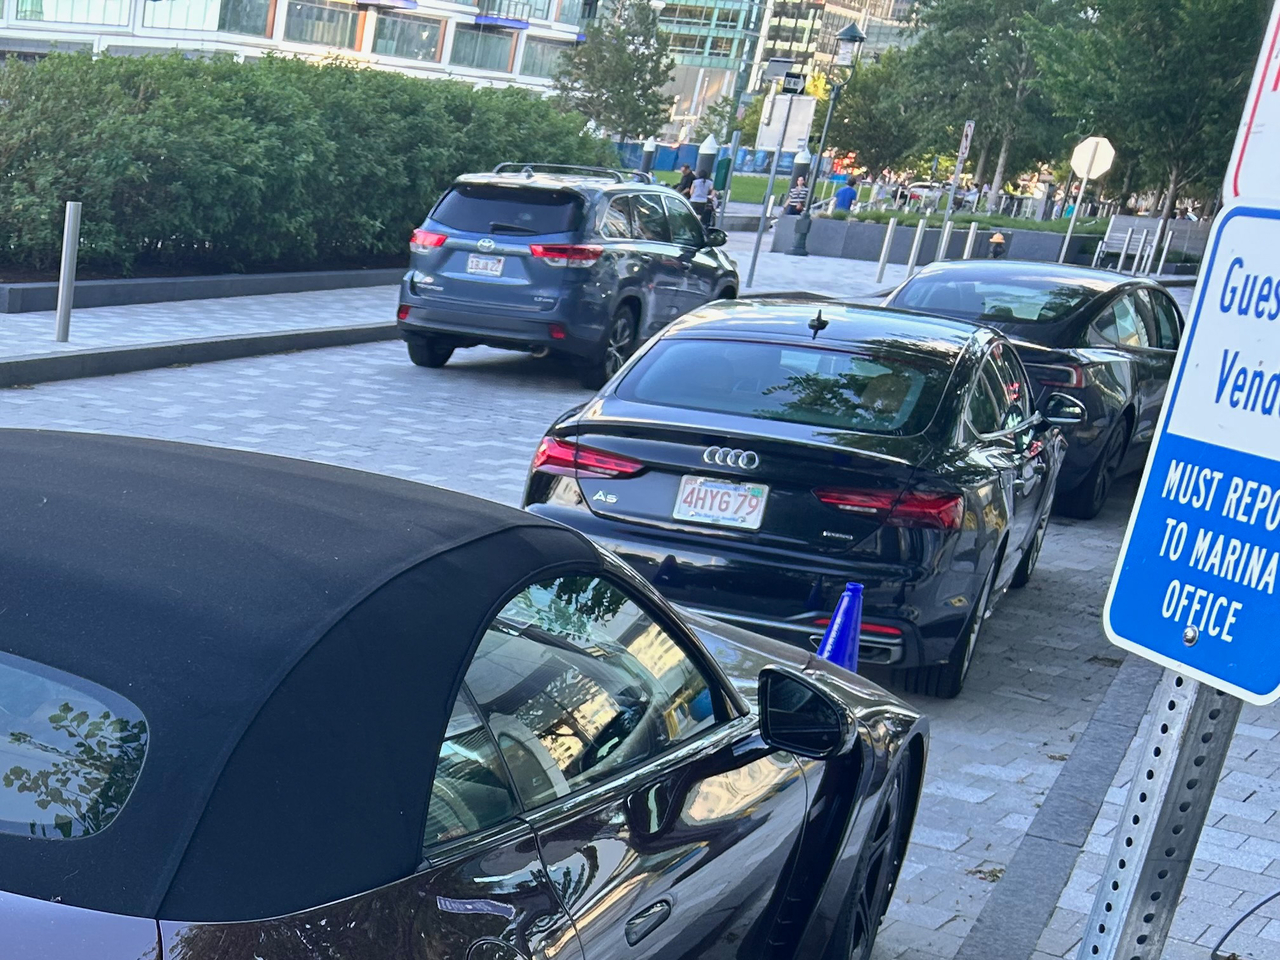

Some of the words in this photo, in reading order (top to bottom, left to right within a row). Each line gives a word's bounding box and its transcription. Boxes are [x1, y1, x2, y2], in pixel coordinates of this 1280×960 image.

[683, 487, 731, 512] 4HYG
[733, 493, 760, 516] 79
[1161, 459, 1224, 512] MUST
[1159, 518, 1188, 561] TO
[1189, 530, 1278, 594] MARINA
[1161, 579, 1243, 643] OFFICE
